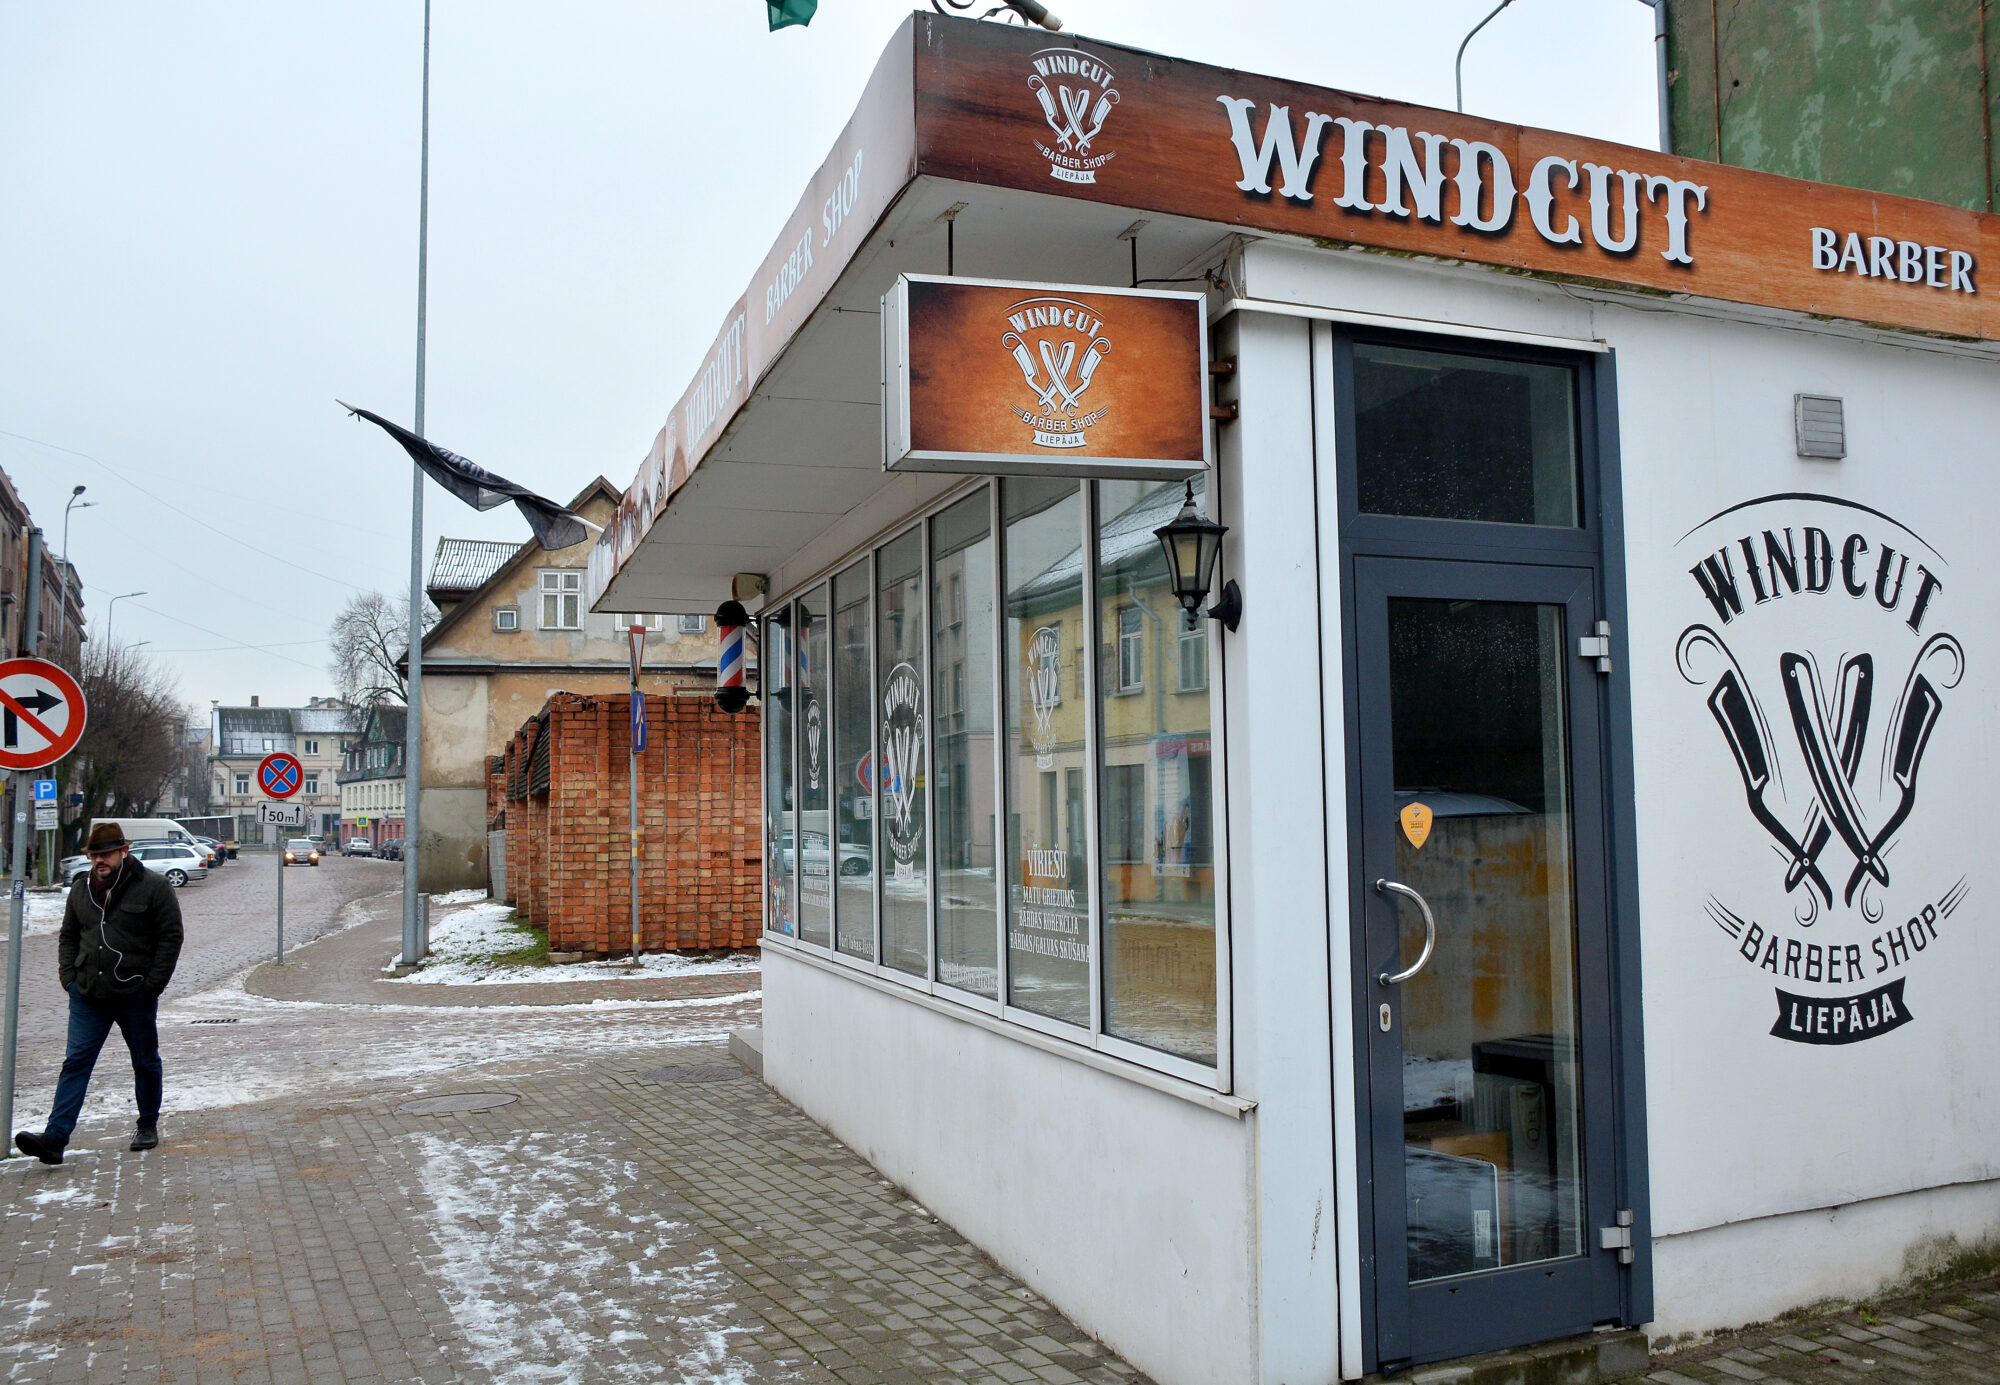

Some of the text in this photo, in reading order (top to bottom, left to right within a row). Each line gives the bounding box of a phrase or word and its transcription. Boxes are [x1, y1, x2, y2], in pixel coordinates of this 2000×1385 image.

[1032, 55, 1114, 89] WINDCUT
[1042, 146, 1106, 169] BARBER SHOP
[1056, 168, 1091, 181] LIEPĀJA
[1216, 95, 1709, 263] WINDCUT
[766, 148, 862, 326] BARBER SHOP
[1809, 227, 1976, 293] BARBER
[1007, 305, 1104, 338] WINDCUT
[686, 311, 746, 457] WINDCUT
[1022, 411, 1097, 431] BARBER SHOP
[1040, 434, 1080, 446] LIEPĀJA
[1688, 526, 1944, 636] WINDCUT
[885, 676, 920, 720] WINDCUT
[40, 782, 53, 798] P
[1027, 843, 1067, 878] VĪRIEŠU
[1023, 886, 1075, 908] MATU GRIEZUMS
[1043, 912, 1079, 935] KOREKCIJA
[1738, 903, 1938, 984] BARBER SHOP
[1790, 992, 1897, 1034] LIEPĀJA
